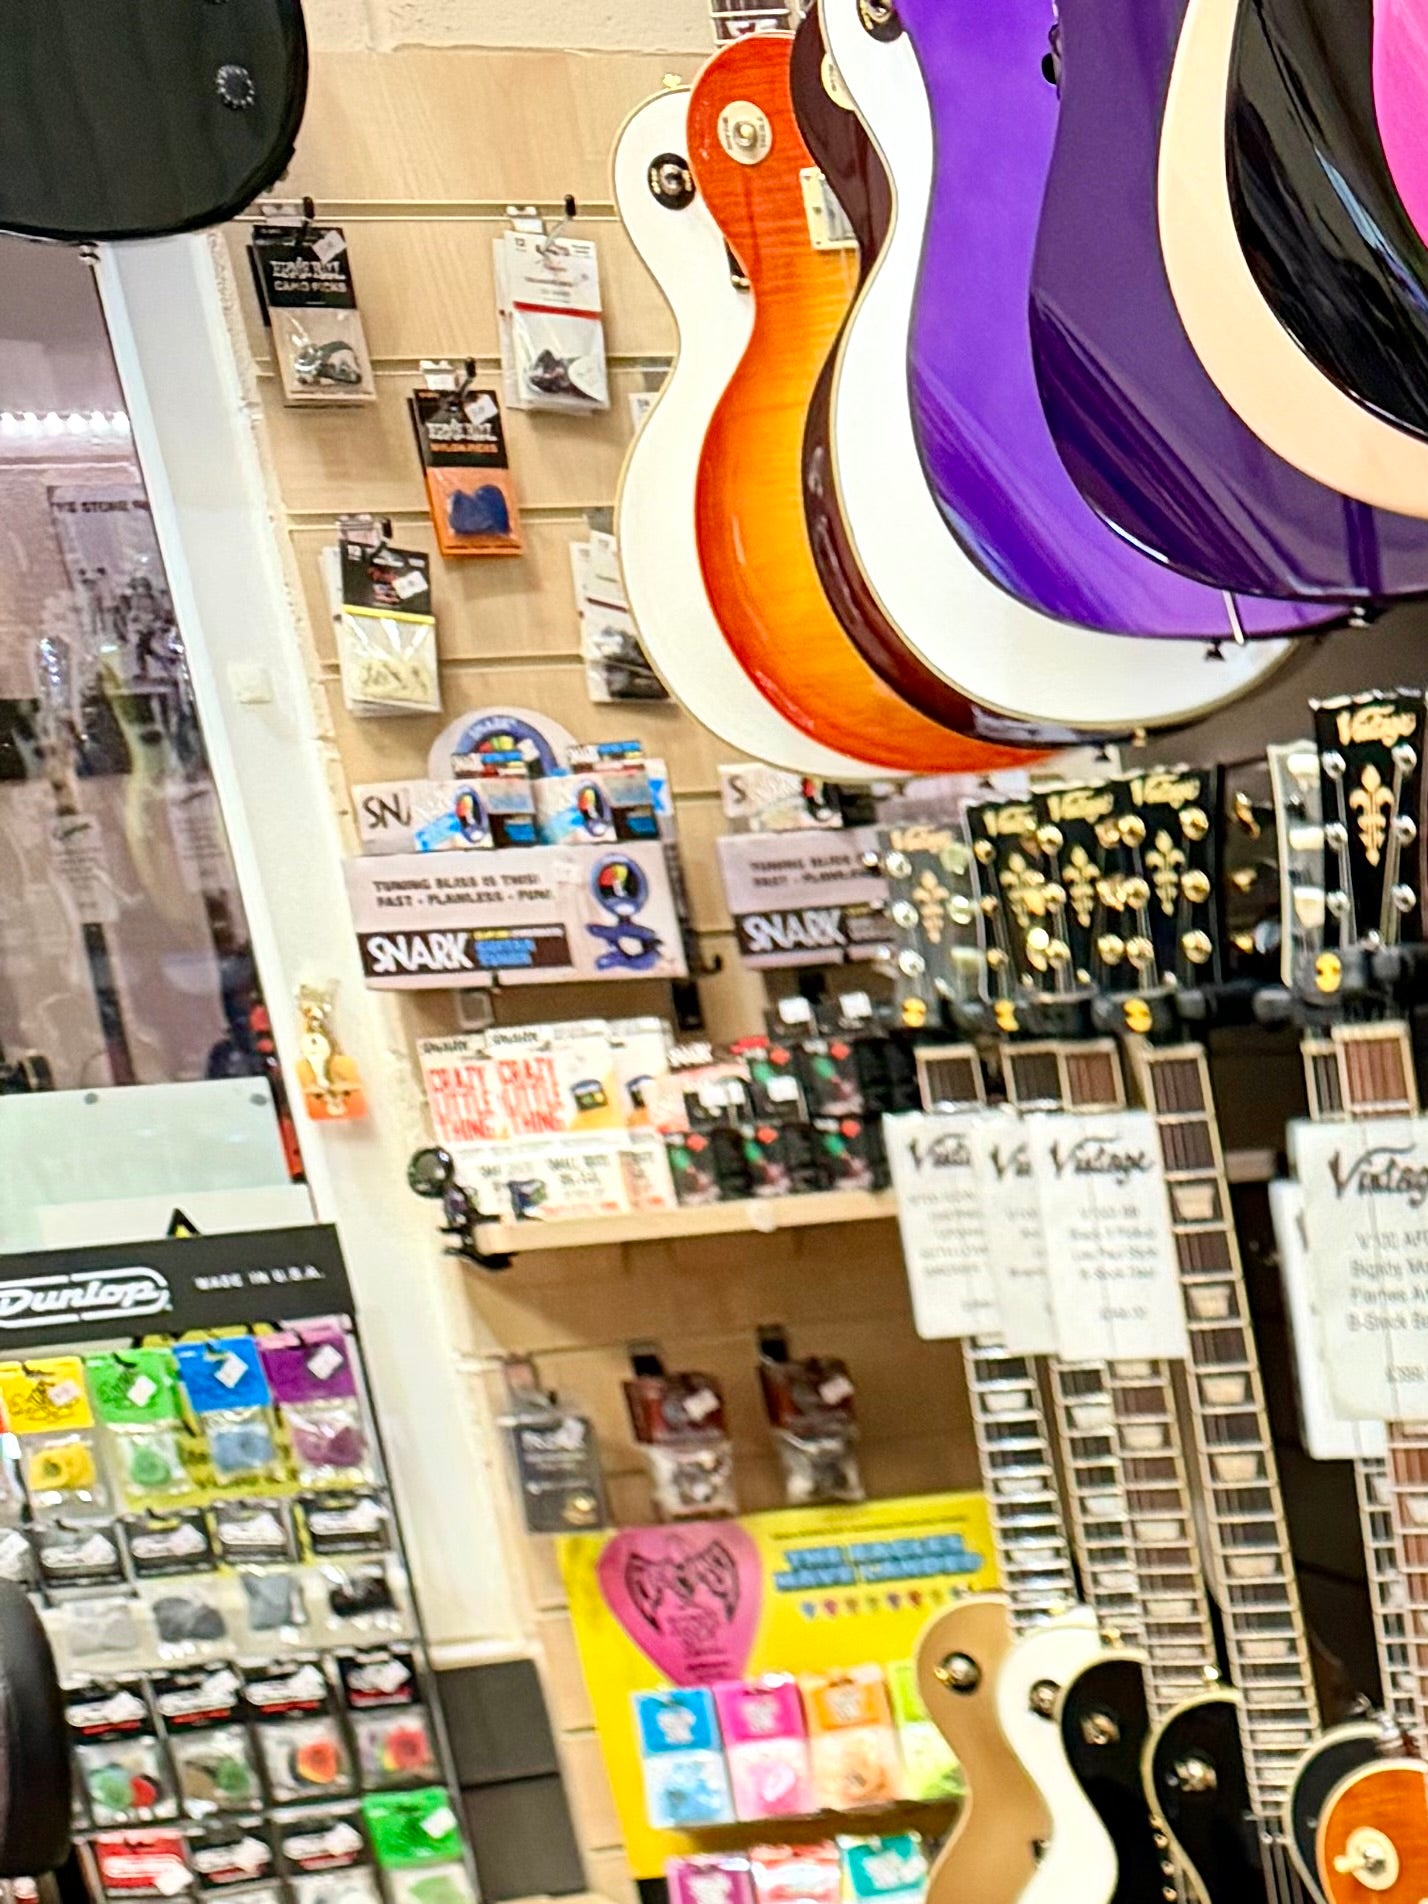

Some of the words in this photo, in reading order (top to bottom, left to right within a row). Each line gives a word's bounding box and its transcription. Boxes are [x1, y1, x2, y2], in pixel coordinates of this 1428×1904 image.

[366, 931, 476, 973] SNARK
[195, 1274, 244, 1291] MADE
[249, 1270, 270, 1286] IN
